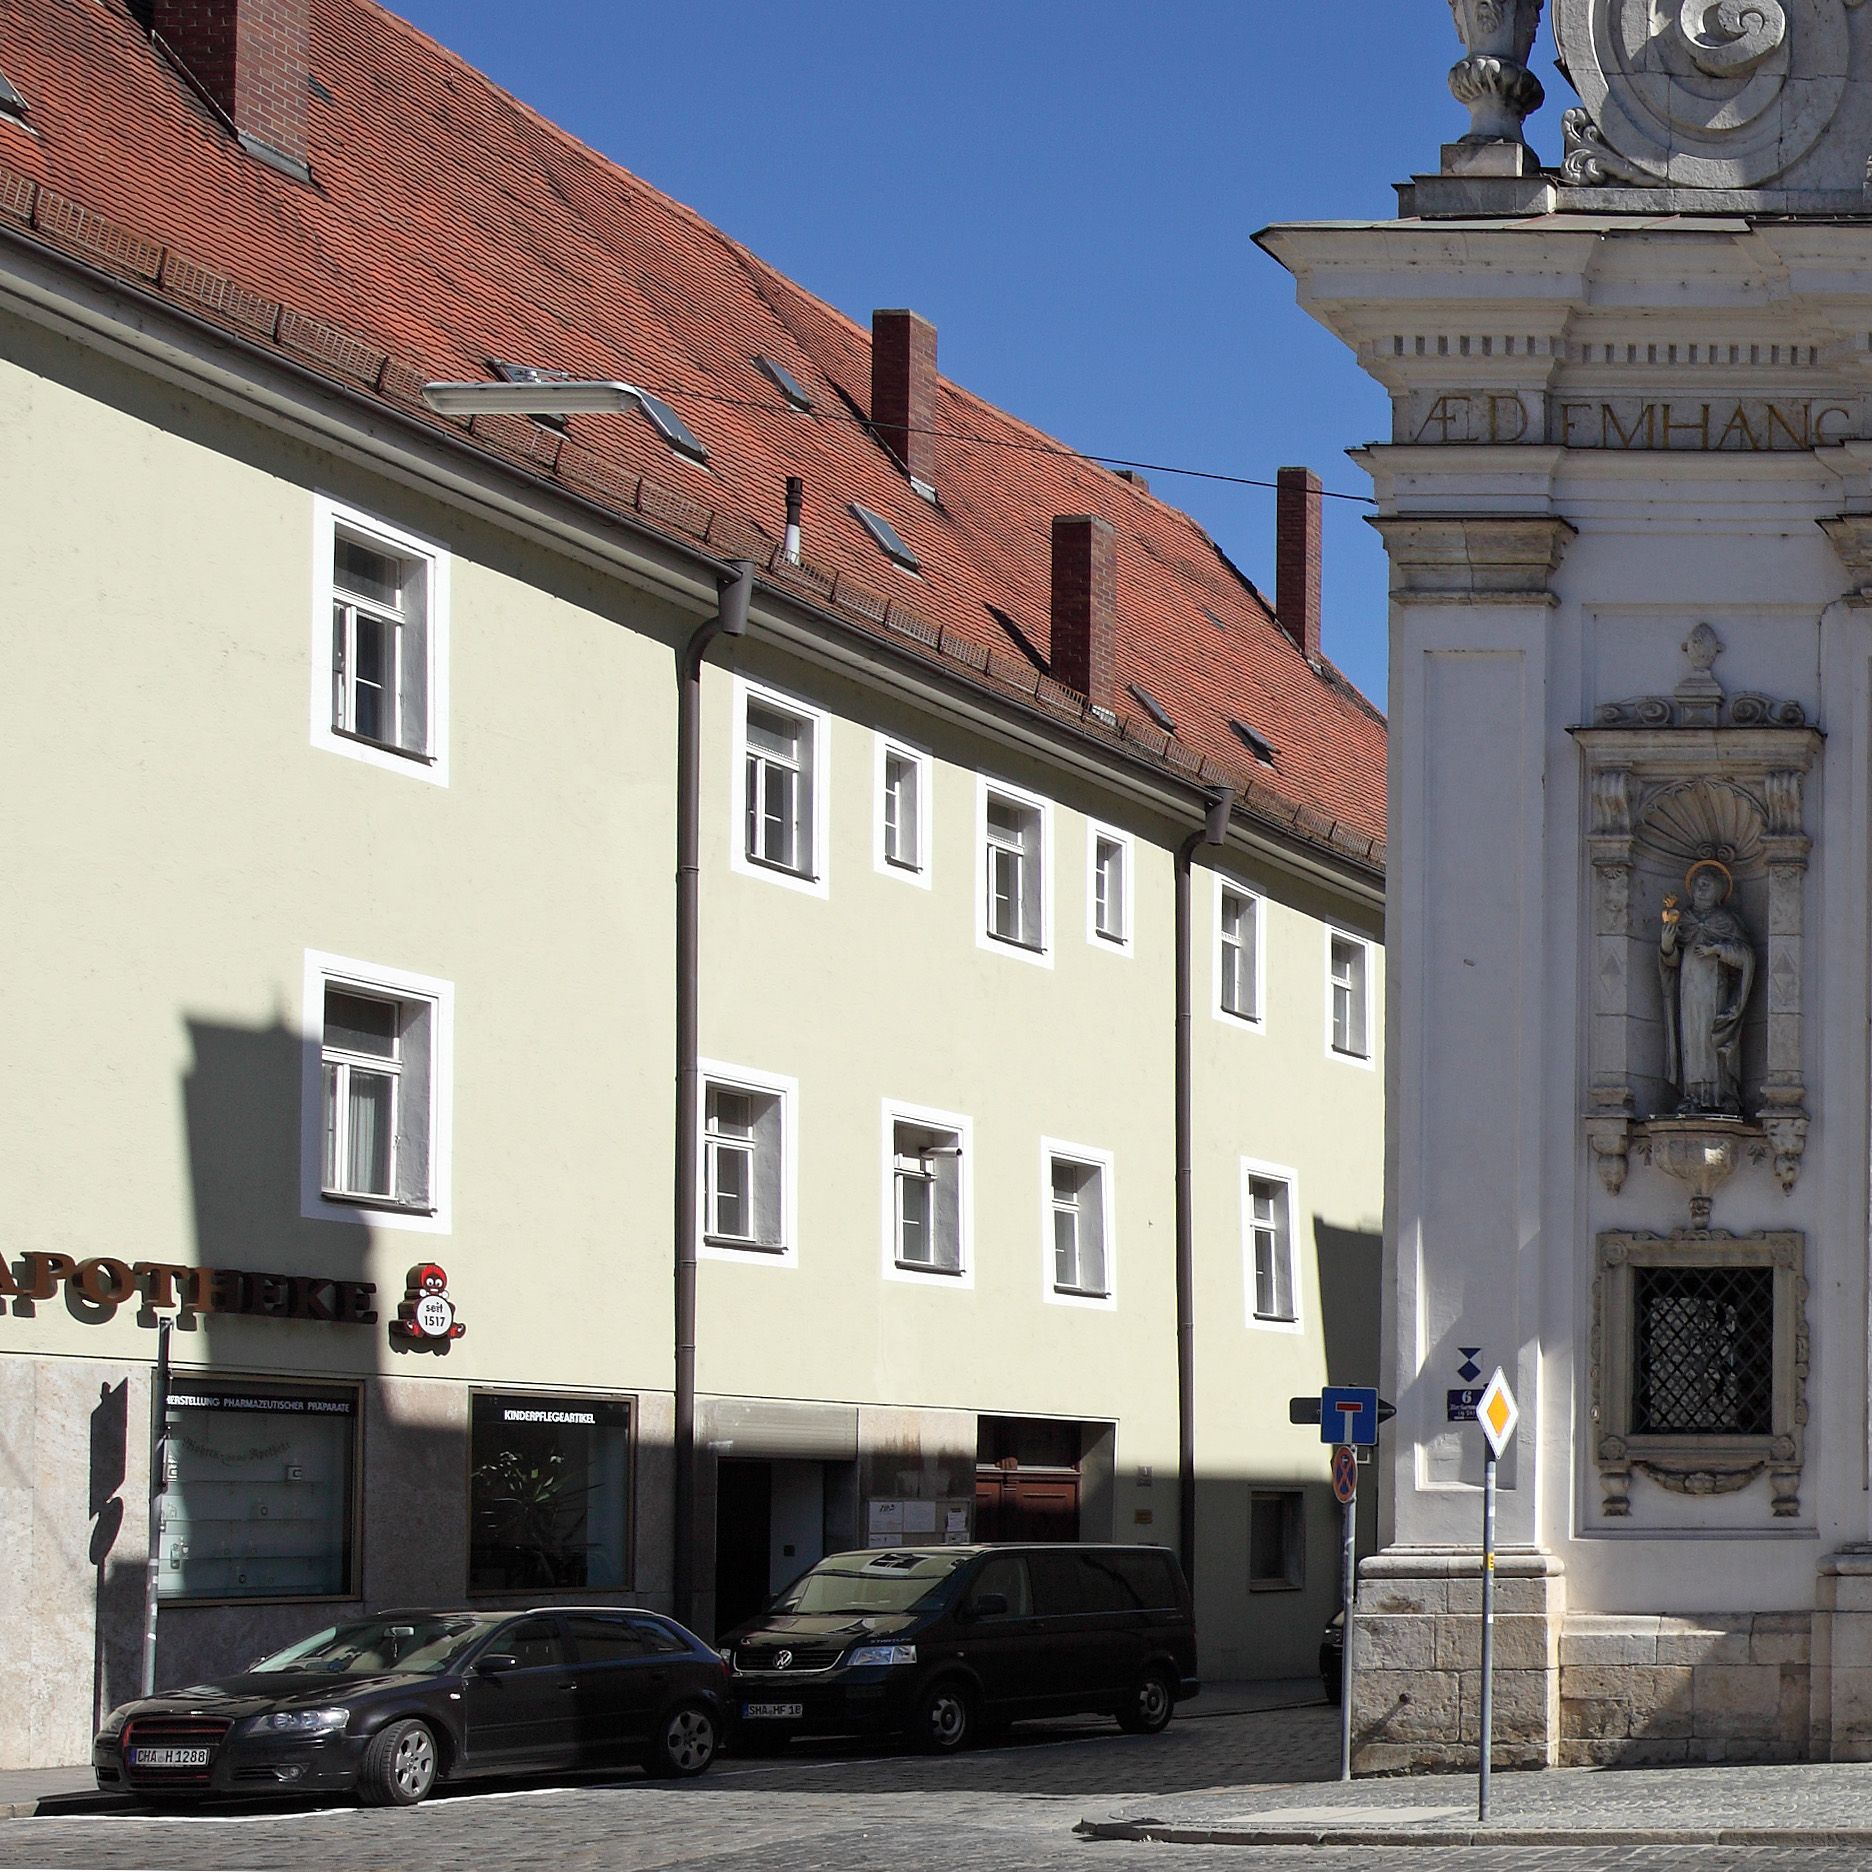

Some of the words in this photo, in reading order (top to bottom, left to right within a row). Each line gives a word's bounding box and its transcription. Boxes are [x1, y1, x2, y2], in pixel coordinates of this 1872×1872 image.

[426, 1302, 443, 1312] seit
[424, 1316, 445, 1327] 1517
[223, 1397, 304, 1411] PHARMAZEUTISCHER
[1462, 1391, 1472, 1404] 6
[504, 1409, 596, 1425] KINDERPFLEGEARTIKEL
[137, 1750, 158, 1762] CHA
[165, 1751, 173, 1763] H
